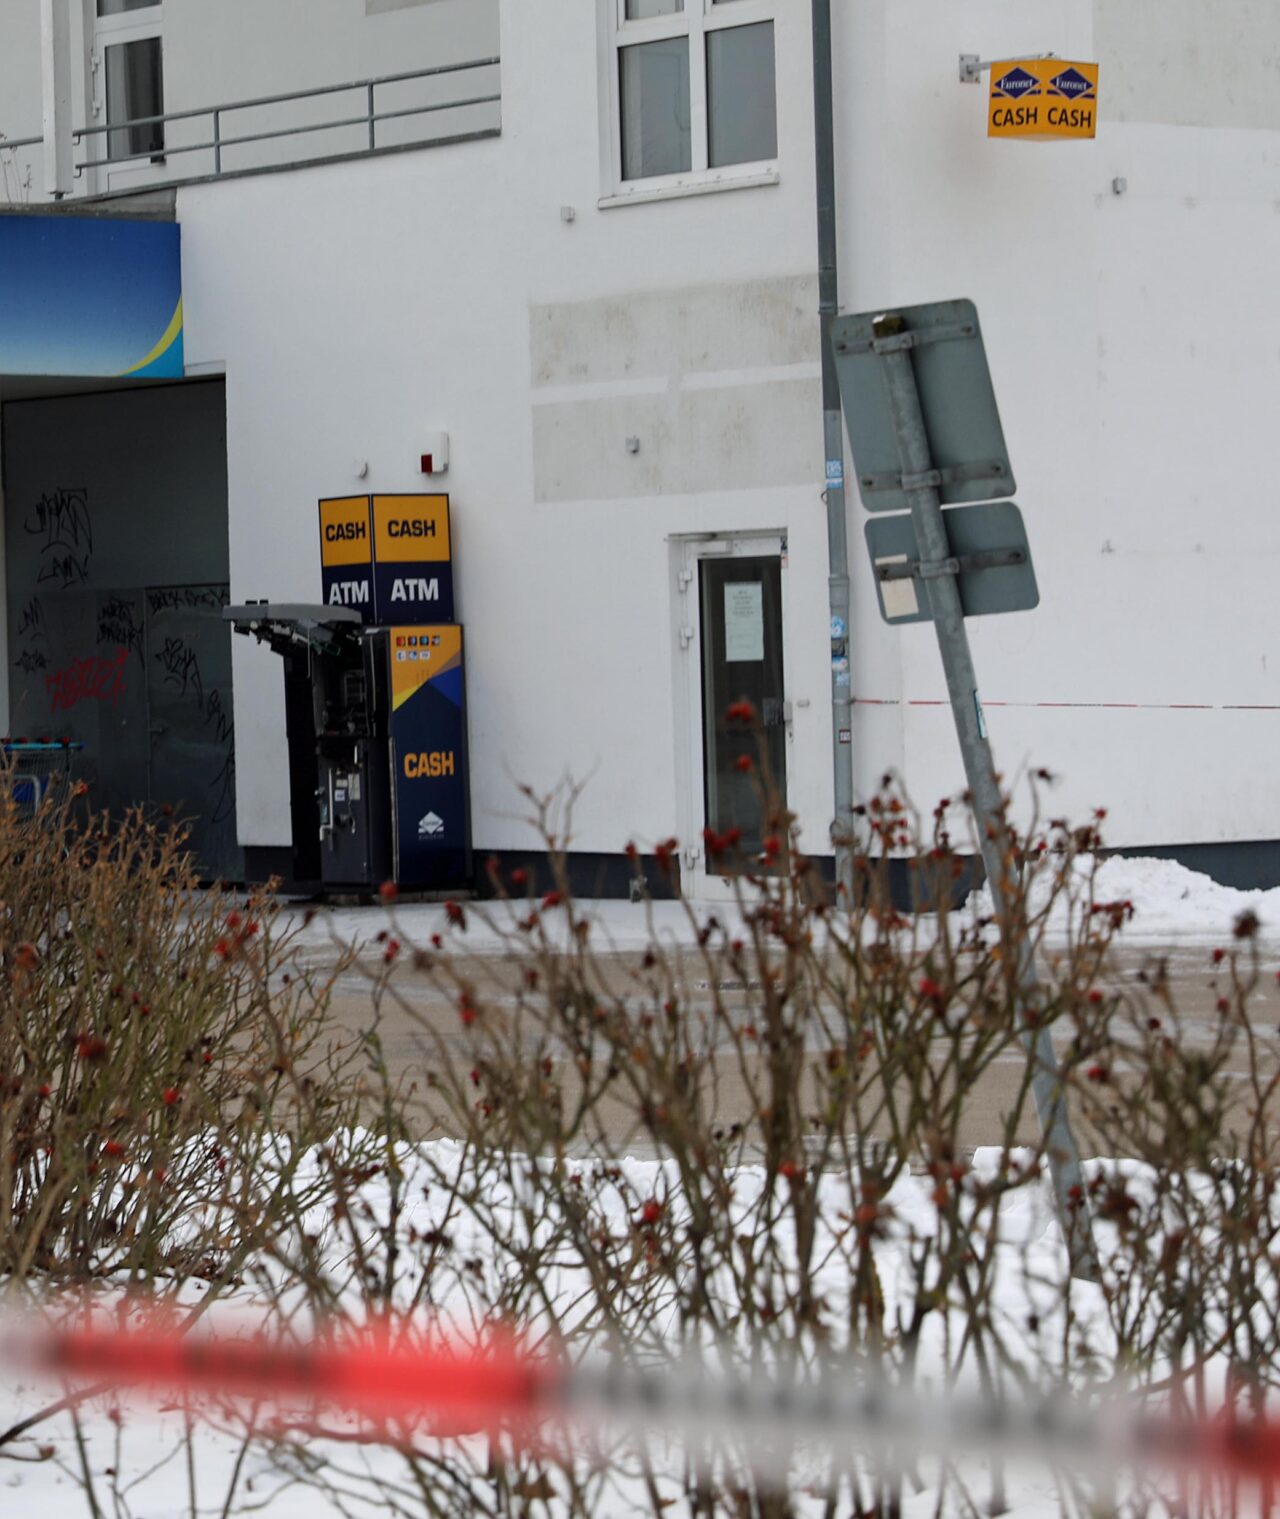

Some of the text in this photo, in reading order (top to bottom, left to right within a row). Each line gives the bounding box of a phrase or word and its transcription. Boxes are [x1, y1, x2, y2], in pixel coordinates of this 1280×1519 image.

[1001, 78, 1033, 90] Euronet
[1056, 77, 1088, 91] Euronet
[992, 107, 1038, 127] CASH
[1047, 107, 1092, 128] CASH
[325, 522, 366, 541] CASH
[387, 519, 436, 538] CASH
[329, 580, 369, 605] ATM
[391, 578, 439, 601] ATM
[404, 751, 454, 778] CASH
